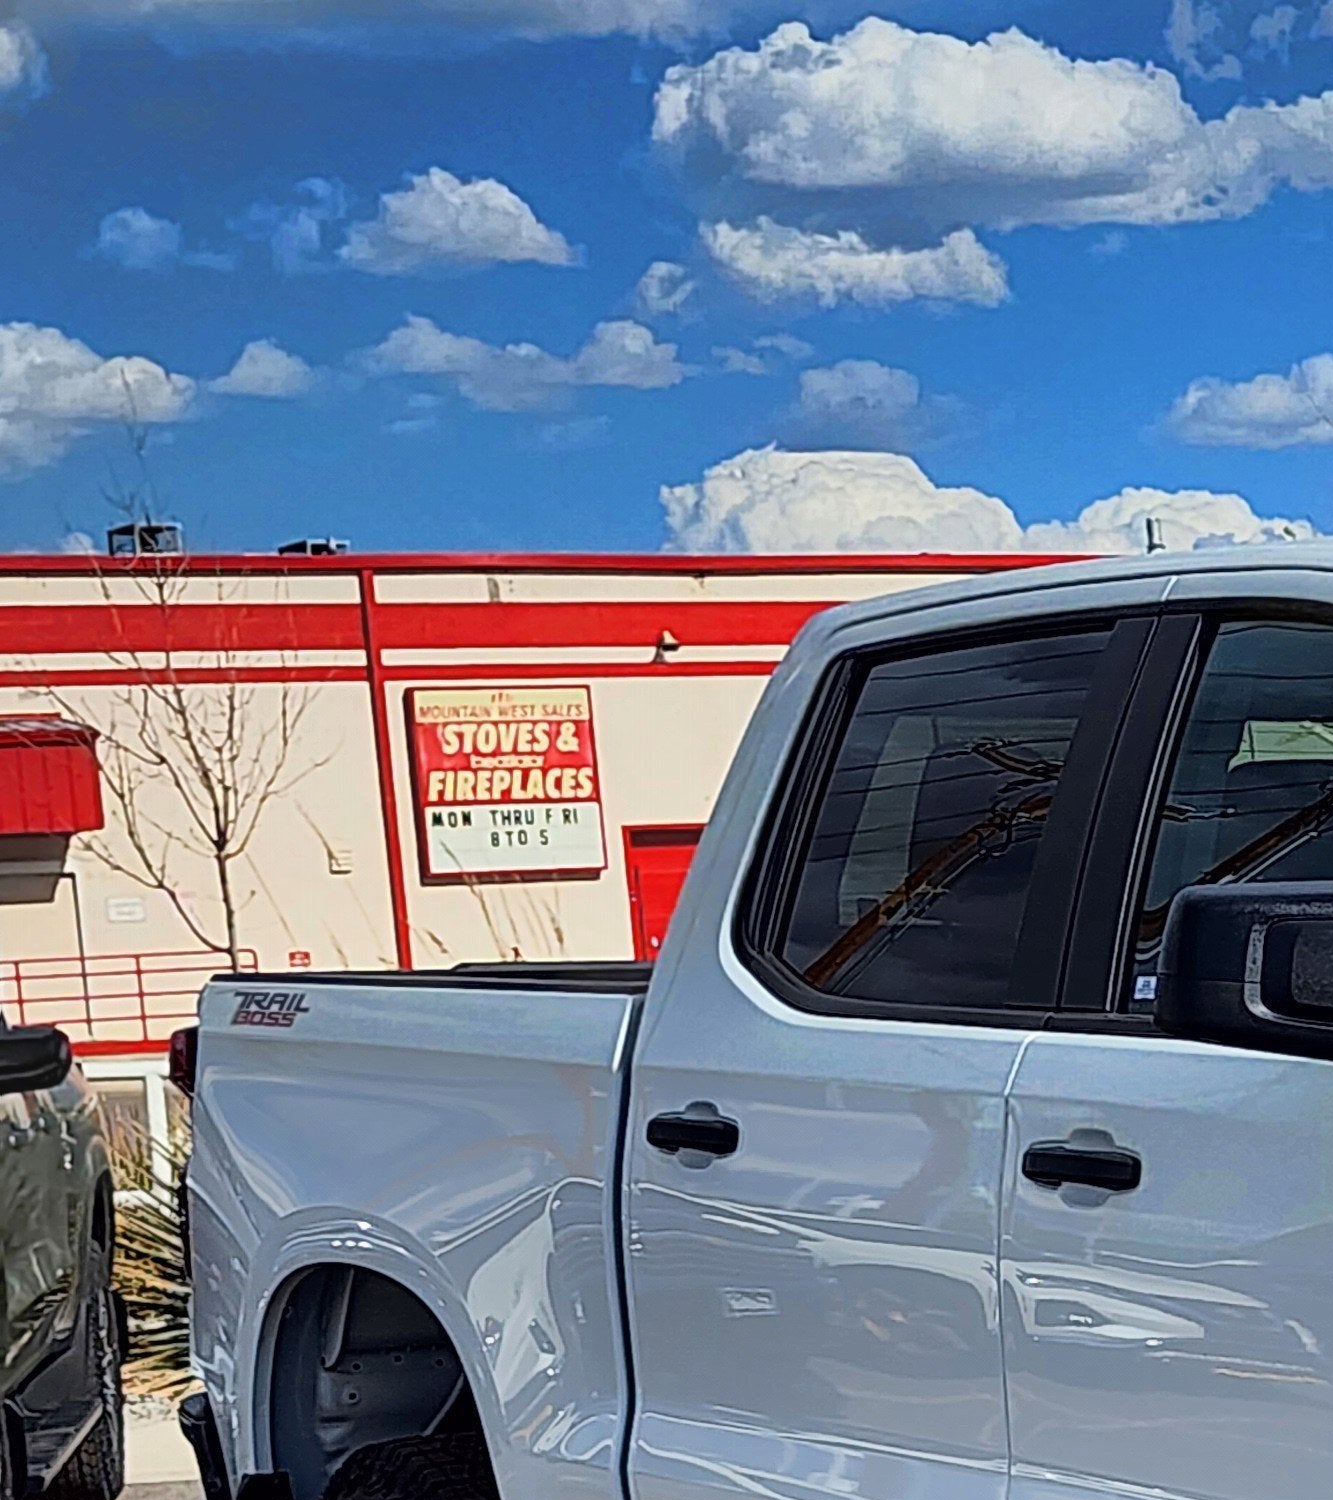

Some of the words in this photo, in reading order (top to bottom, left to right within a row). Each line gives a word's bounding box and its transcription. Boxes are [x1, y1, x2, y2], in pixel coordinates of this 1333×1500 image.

[419, 704, 491, 719] MOUNTAIN
[499, 704, 536, 718] WEST
[542, 703, 583, 718] SALES
[441, 722, 550, 755] STOVES
[555, 722, 580, 752] &
[427, 767, 594, 802] FIREPLACES
[431, 810, 472, 829] MON
[489, 808, 535, 827] THRU
[233, 991, 310, 1013] TRAIL
[230, 1010, 298, 1028] BOSS
